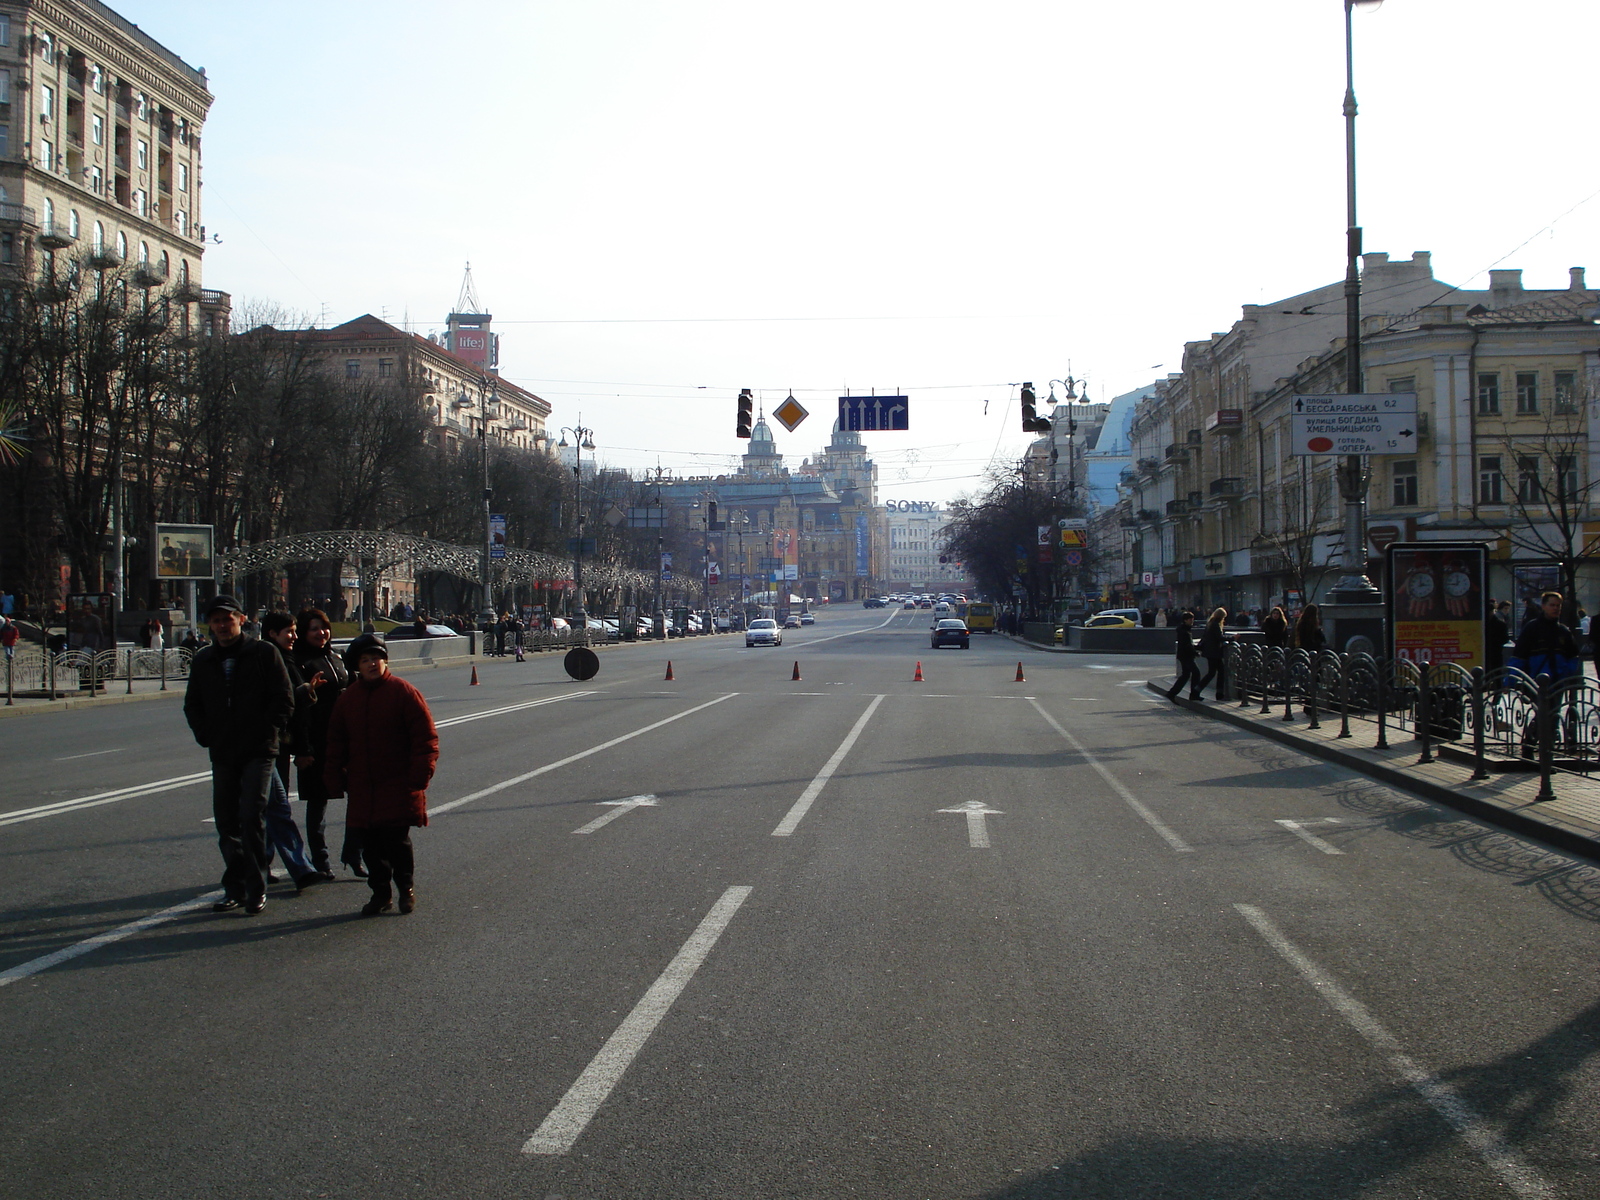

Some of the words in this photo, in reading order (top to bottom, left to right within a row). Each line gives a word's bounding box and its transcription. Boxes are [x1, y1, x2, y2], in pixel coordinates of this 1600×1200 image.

[460, 336, 485, 350] life:)
[1306, 404, 1377, 413] БЕССАРАБСЬКА
[1384, 400, 1397, 408] 0,2
[1306, 418, 1336, 426] вулиця
[1338, 416, 1380, 425] БОГДАНА
[1306, 424, 1382, 433] ХМЕЛЬНИЦЬКОГО
[886, 499, 936, 513] SONY
